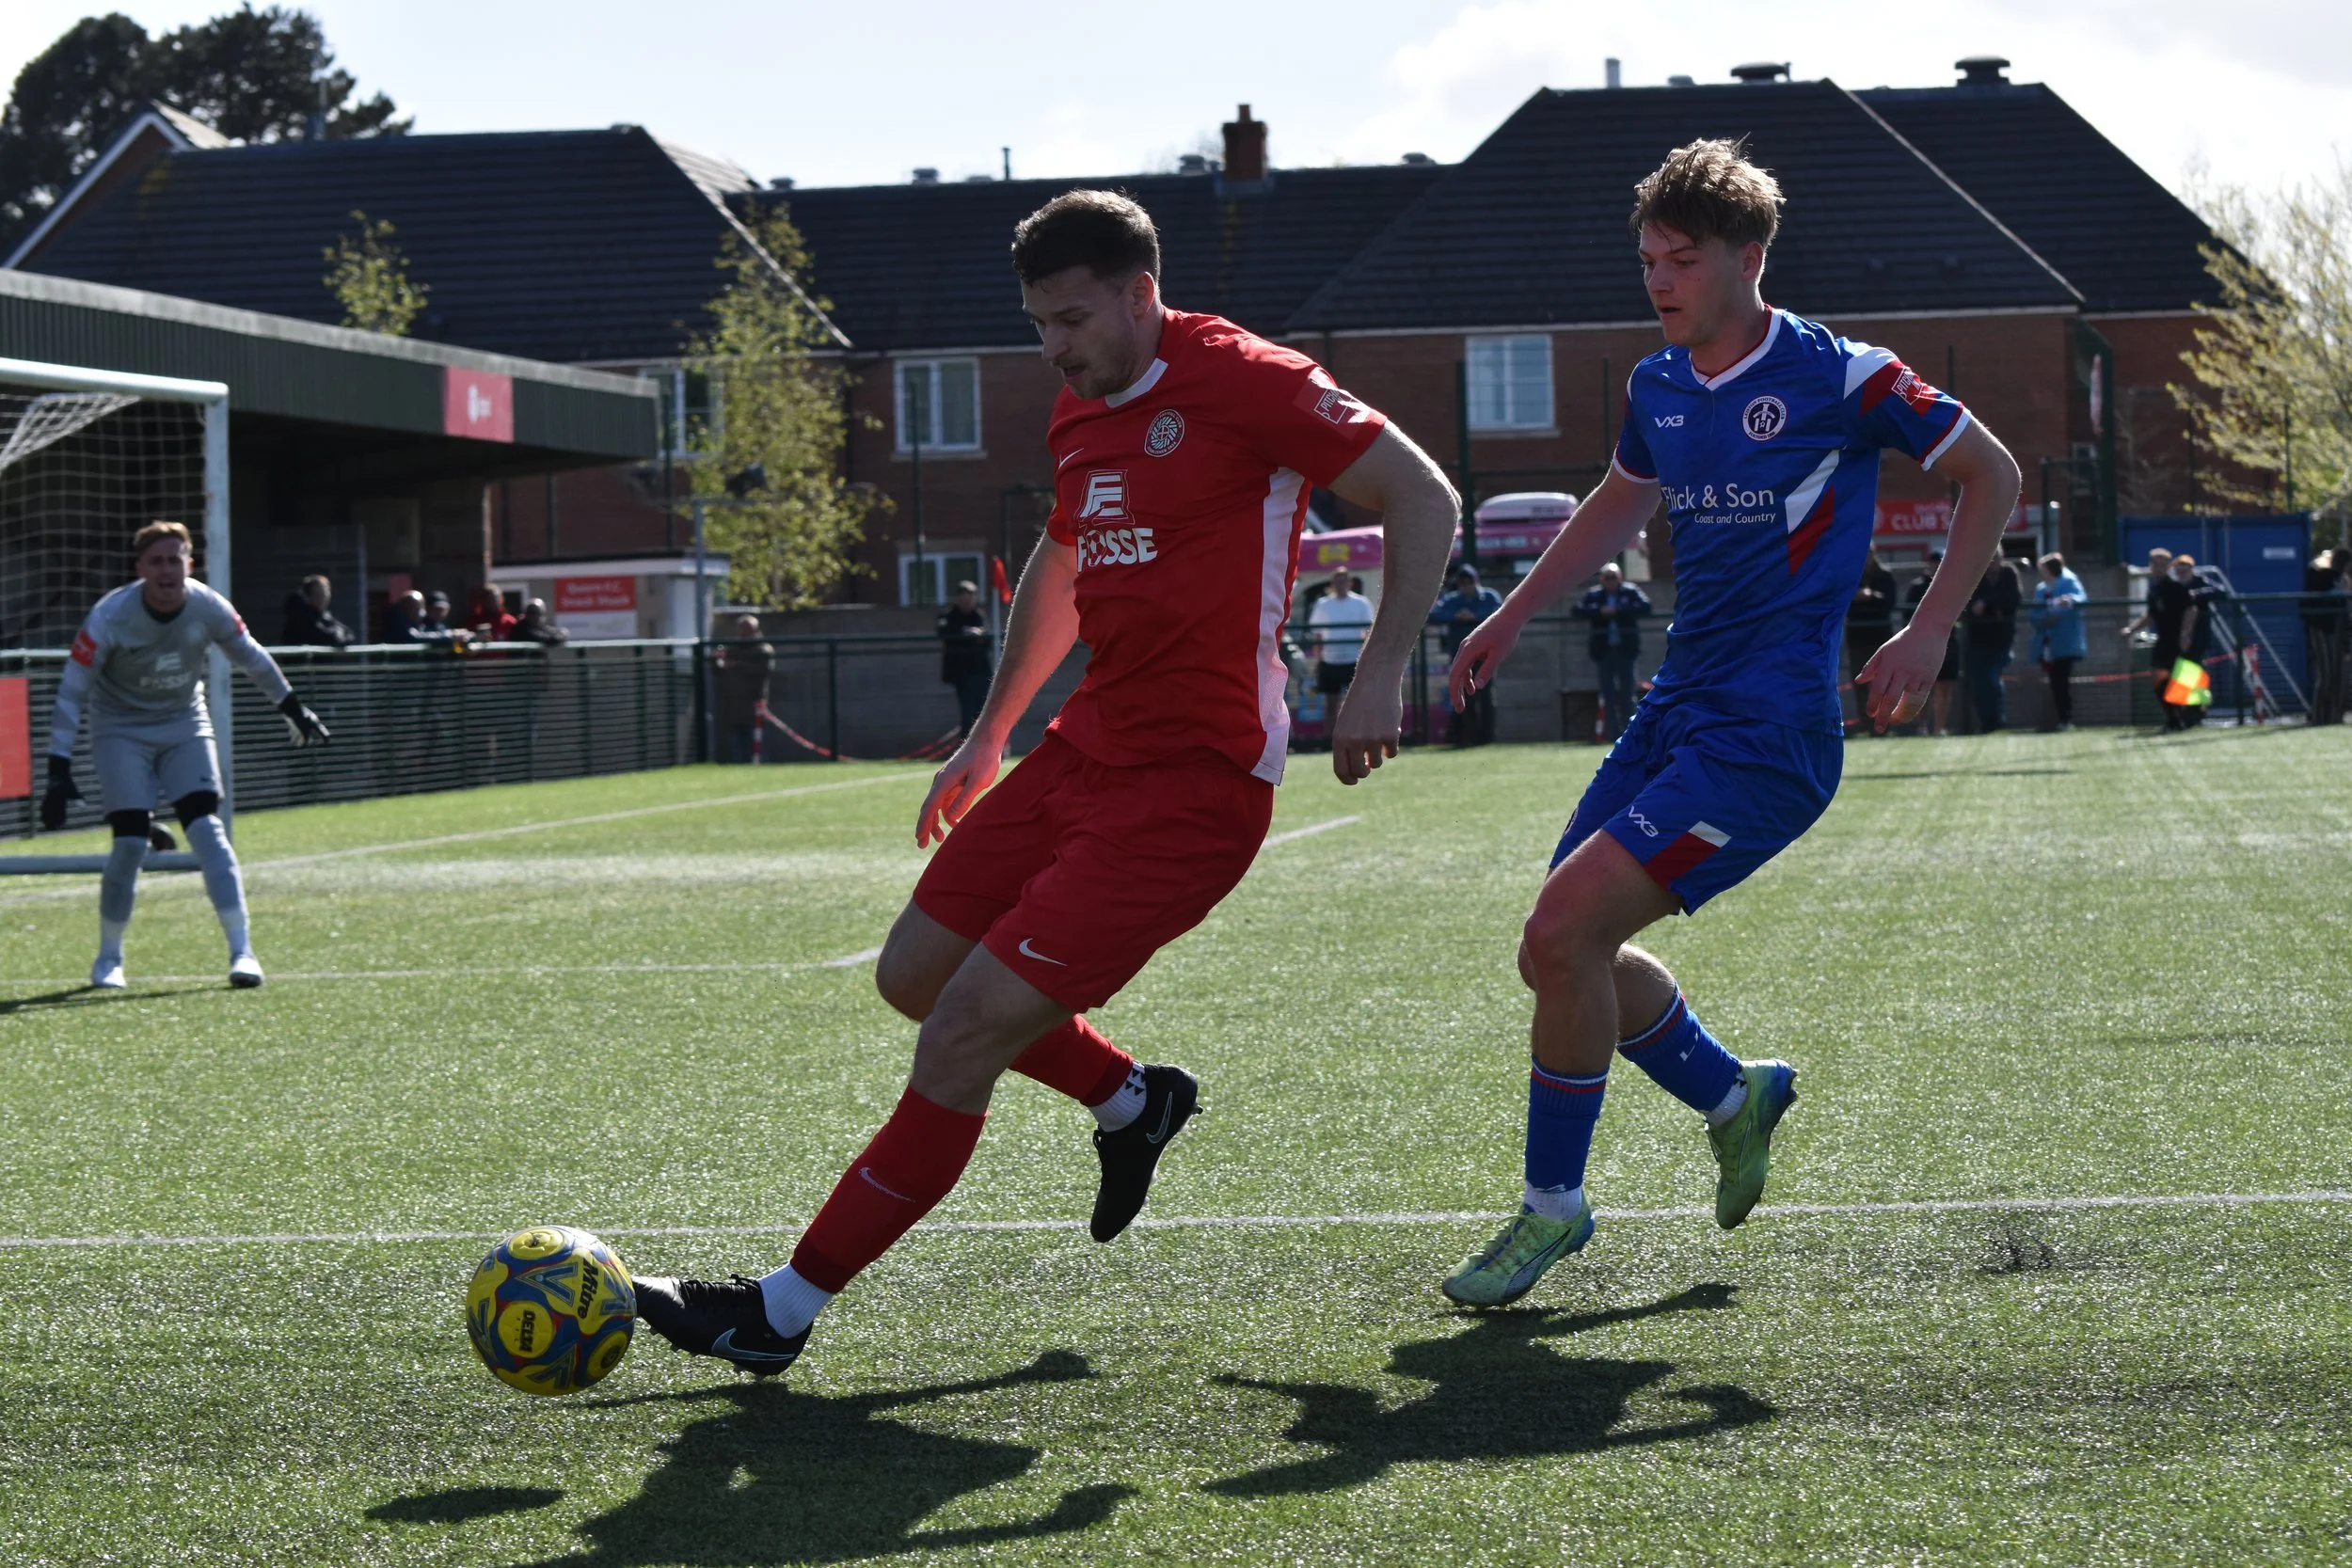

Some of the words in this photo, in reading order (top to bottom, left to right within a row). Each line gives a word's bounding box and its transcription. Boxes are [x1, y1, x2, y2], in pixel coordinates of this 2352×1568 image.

[1654, 415, 1684, 428] VX3
[1661, 485, 1696, 510] Flick
[1702, 484, 1719, 508] &
[1725, 483, 1774, 508] Son
[1694, 513, 1714, 524] Coast
[1716, 513, 1732, 524] and
[1735, 513, 1776, 524] Country
[1629, 805, 1659, 837] VX3
[578, 1259, 599, 1320] Mitre
[519, 1309, 536, 1353] DELTA
